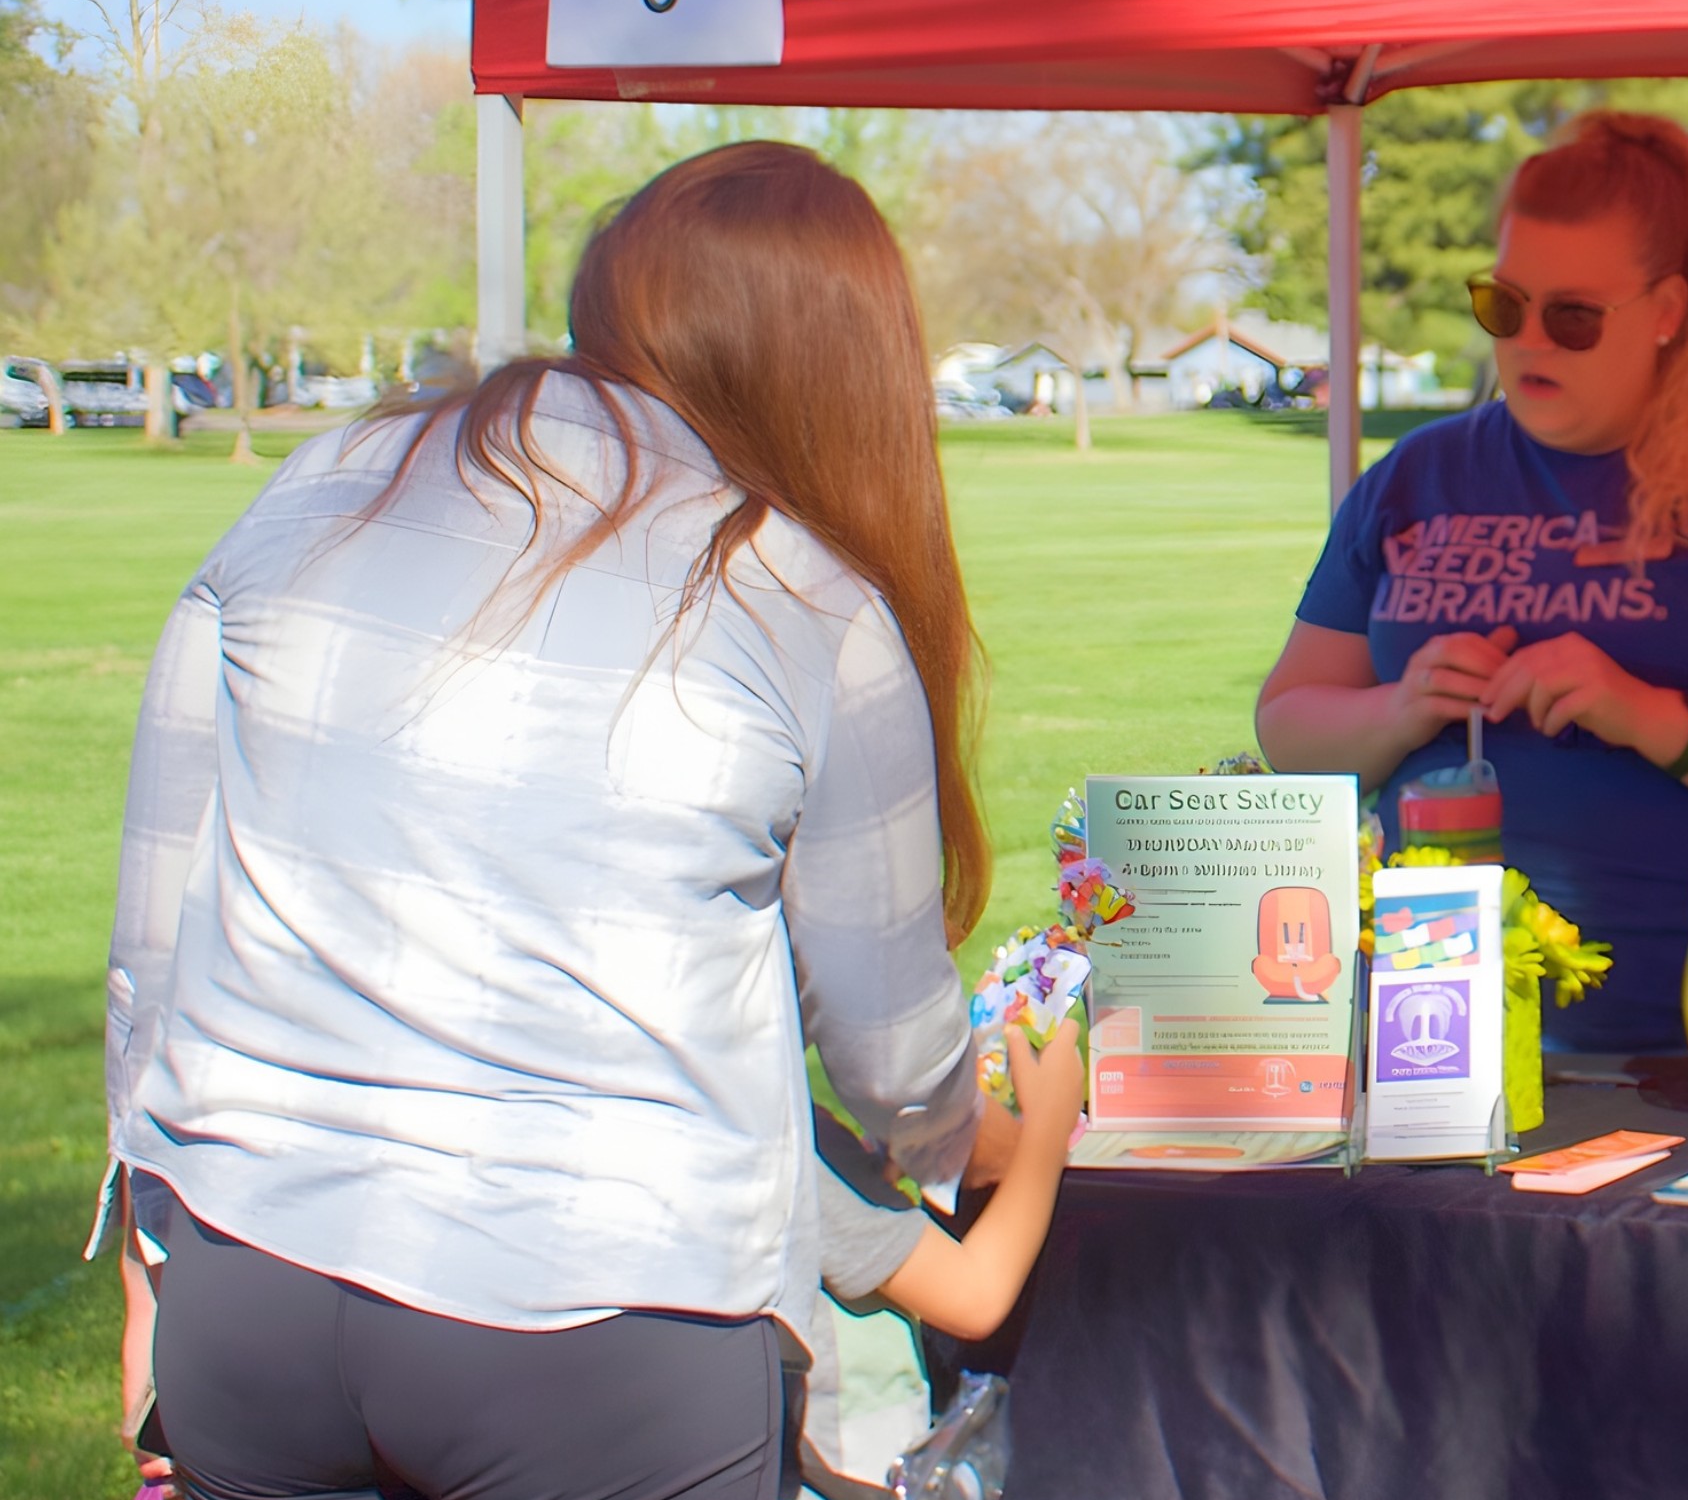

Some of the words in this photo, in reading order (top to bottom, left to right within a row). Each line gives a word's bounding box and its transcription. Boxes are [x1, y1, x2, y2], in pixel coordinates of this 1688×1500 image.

[1396, 510, 1598, 550] AMERICA
[1115, 789, 1161, 811] Car
[1169, 789, 1228, 811] Seat
[1237, 788, 1324, 815] Safety
